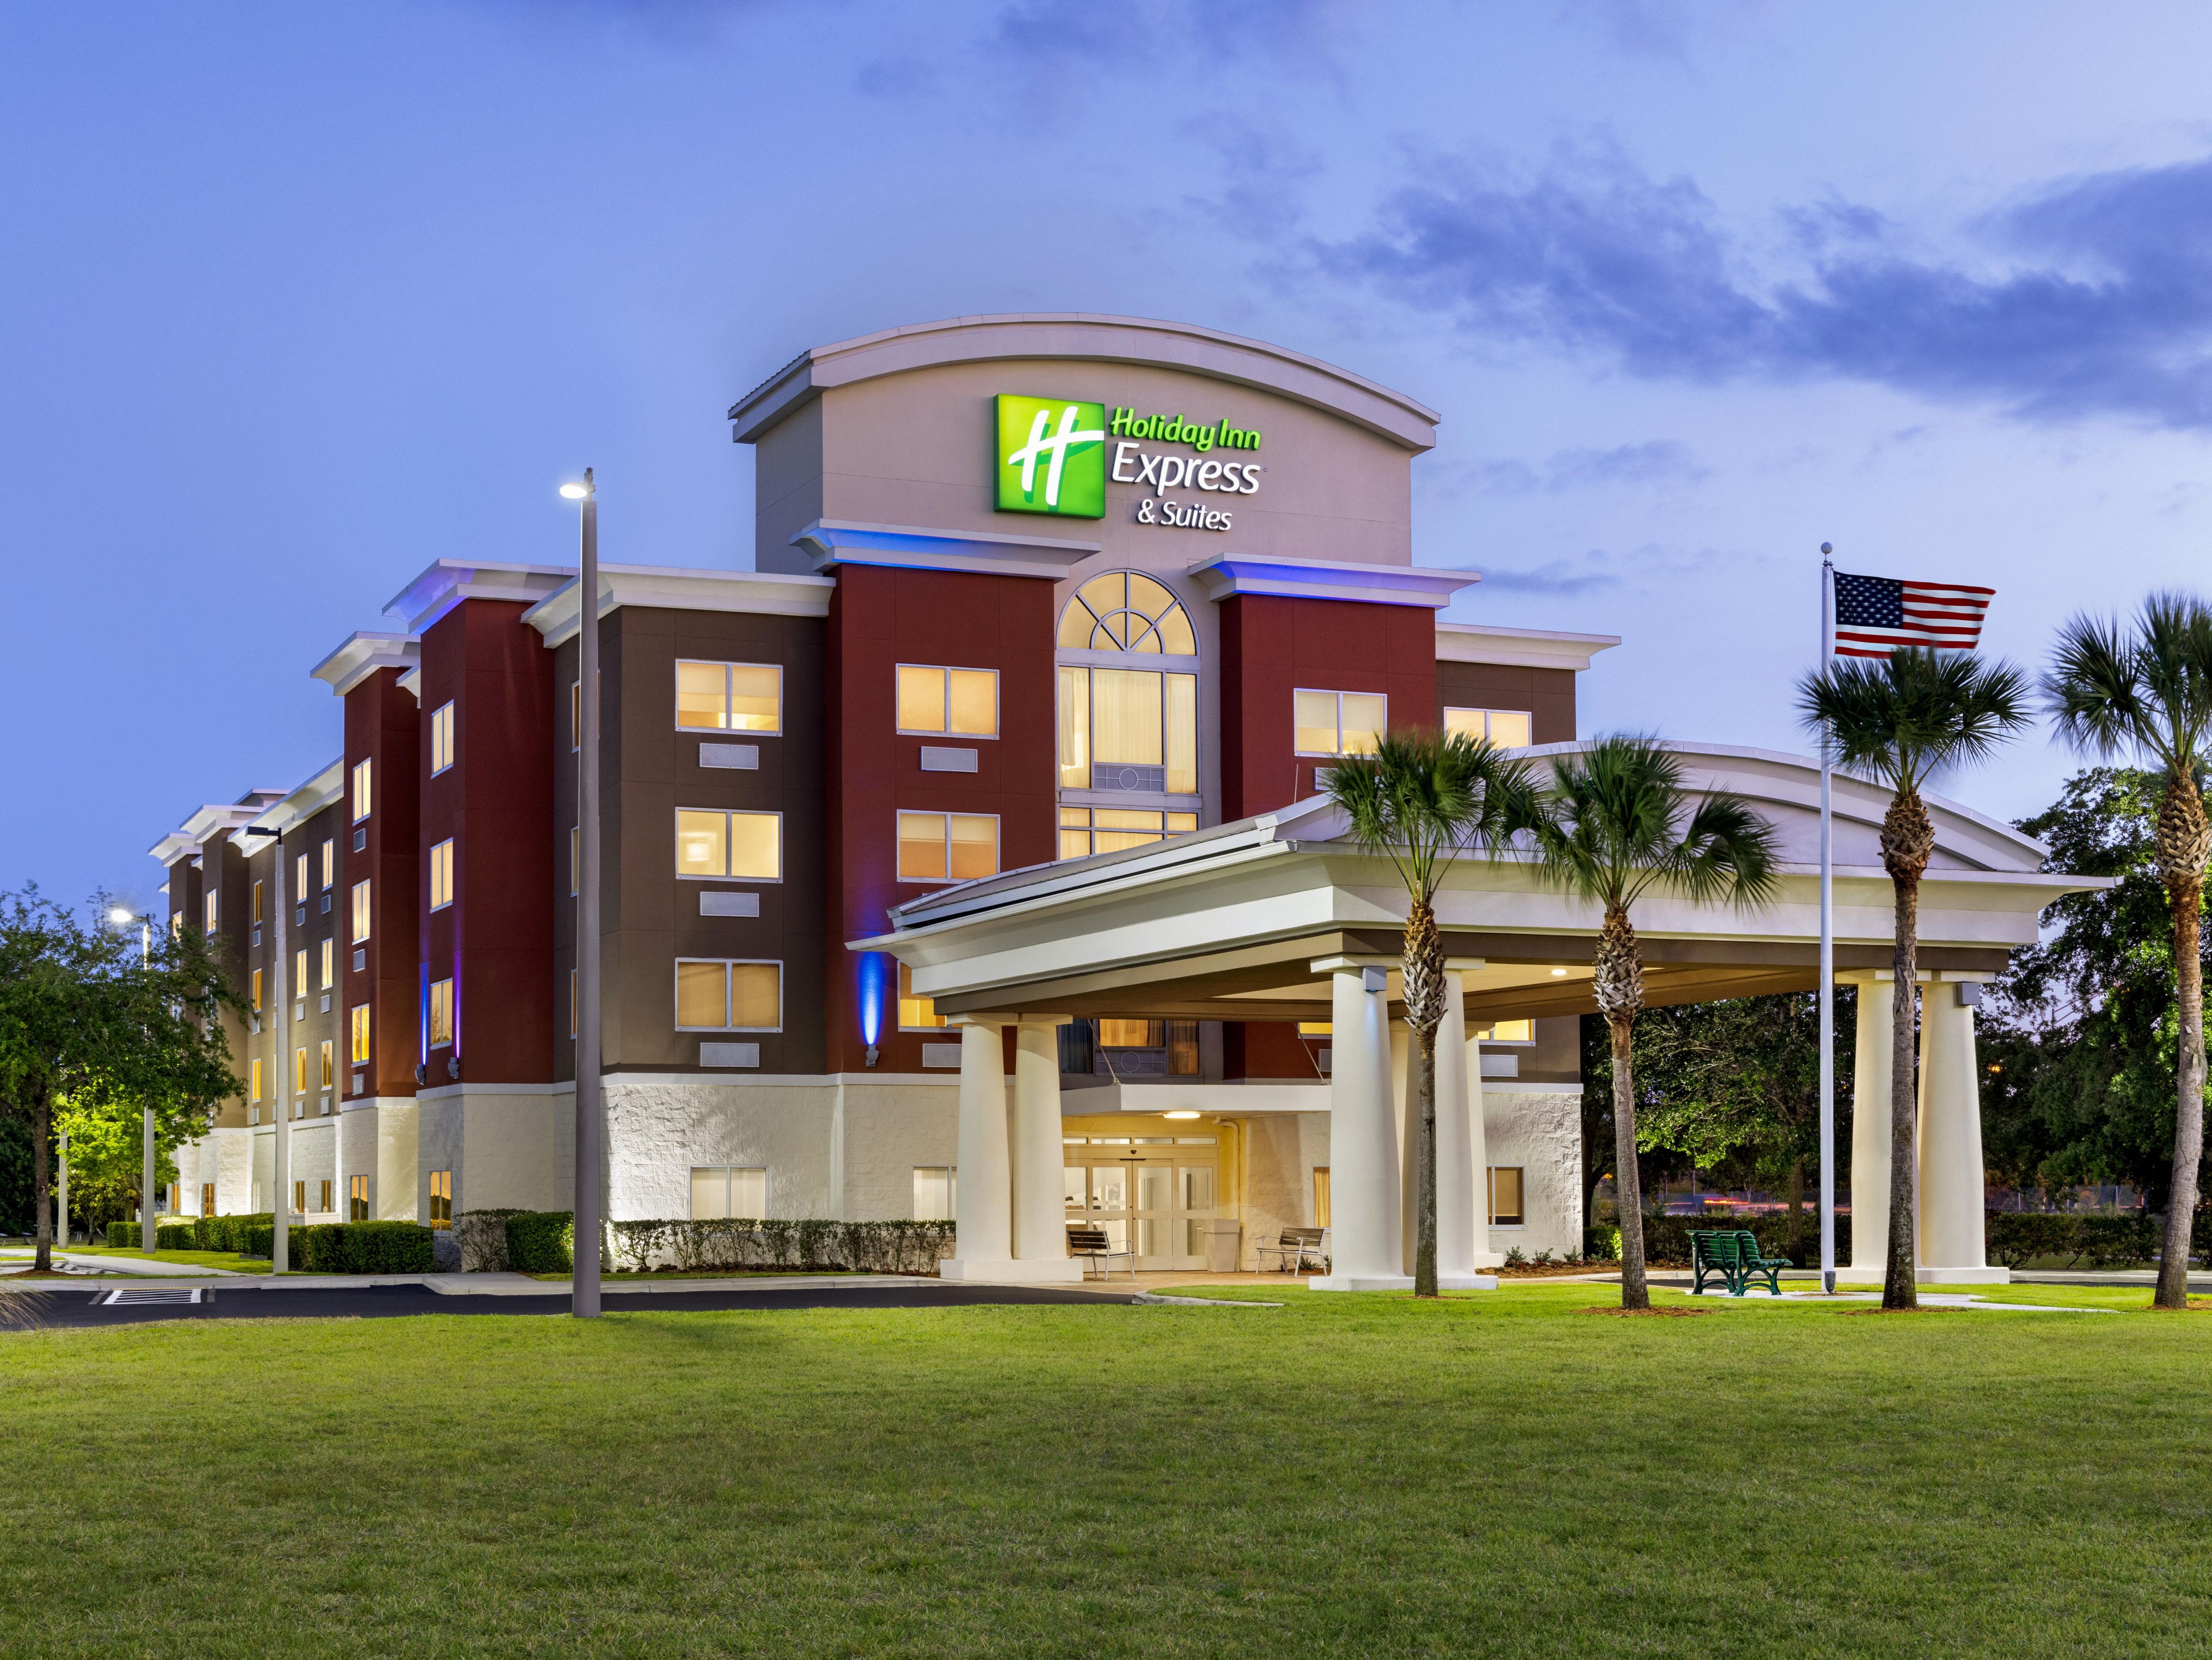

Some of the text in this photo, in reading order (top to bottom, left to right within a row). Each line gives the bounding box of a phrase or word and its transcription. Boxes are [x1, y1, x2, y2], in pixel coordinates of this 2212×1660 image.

[1110, 407, 1261, 452] Holiday Inn
[1110, 441, 1261, 497] Express
[1137, 499, 1232, 531] & Suites
